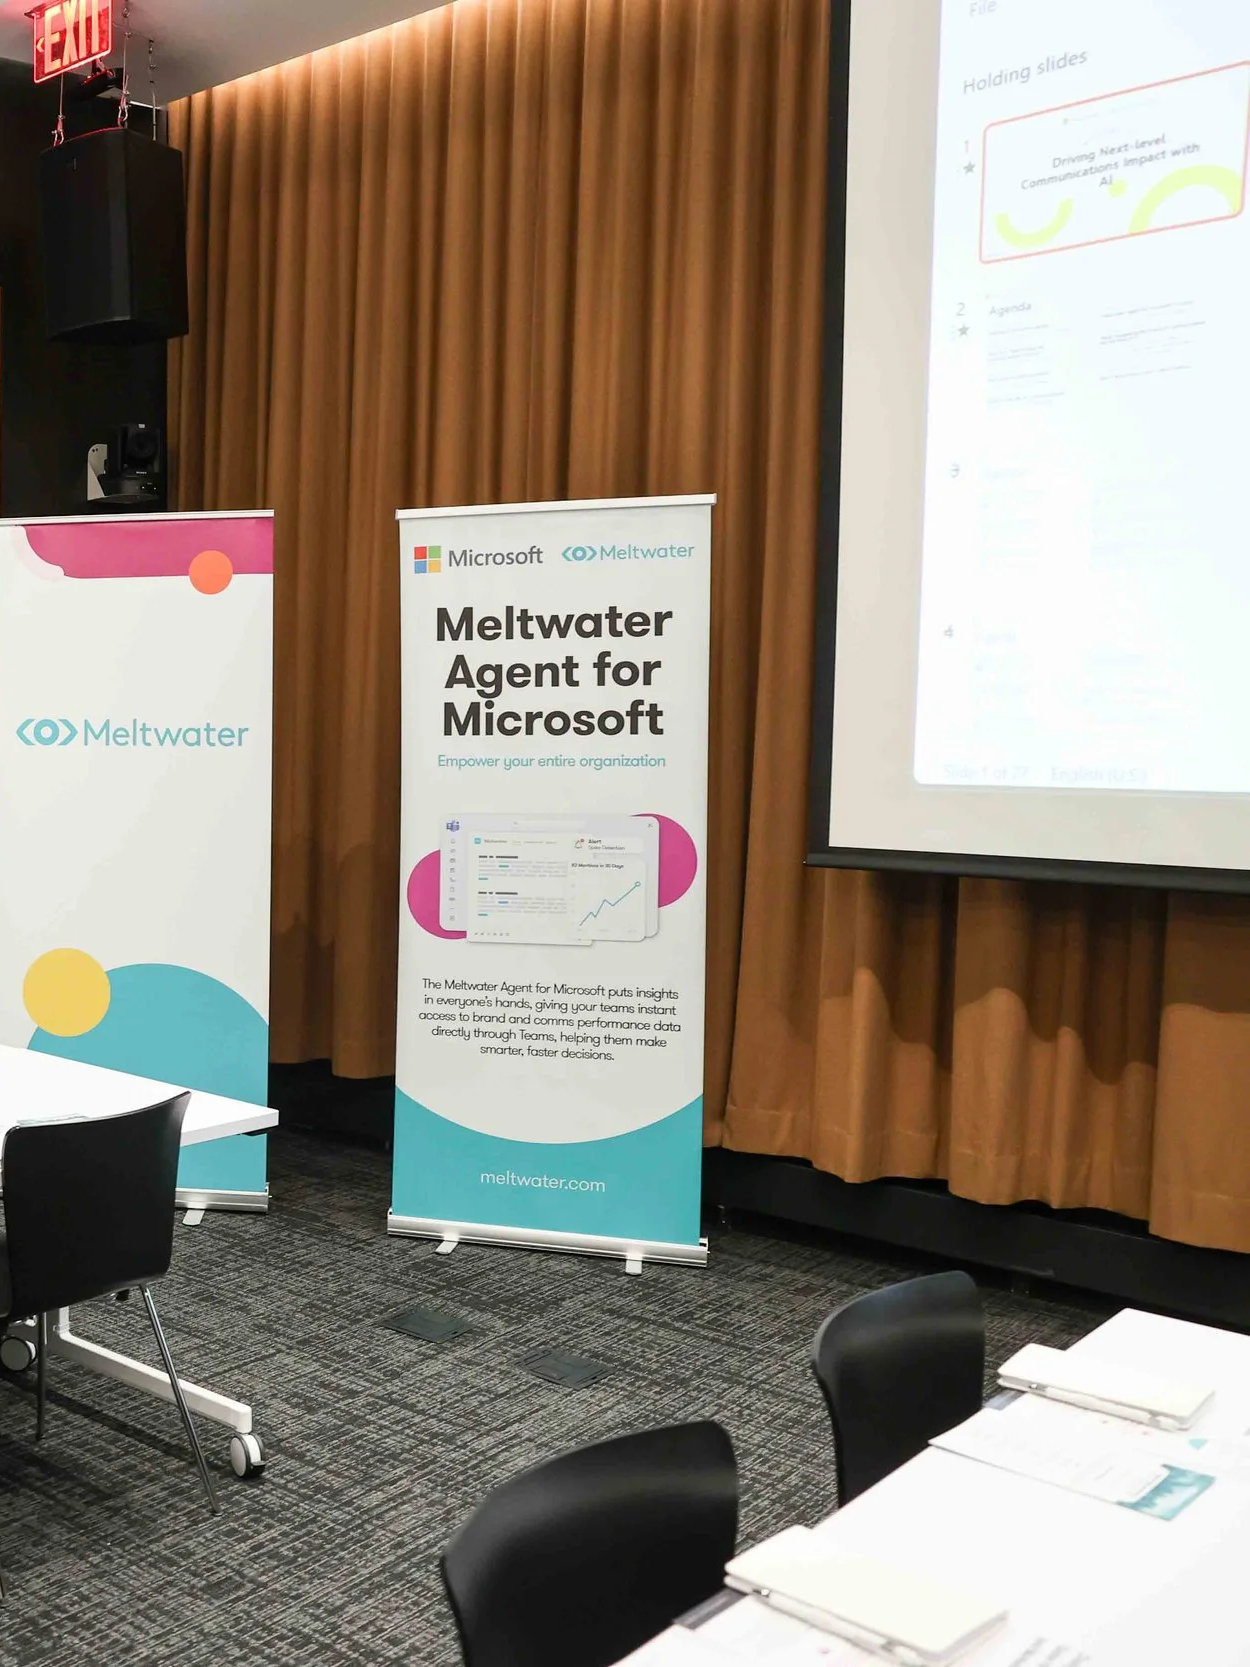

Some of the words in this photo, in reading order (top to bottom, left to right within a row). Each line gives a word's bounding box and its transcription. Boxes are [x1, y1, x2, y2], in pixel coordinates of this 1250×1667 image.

[44, 0, 99, 74] EXIT
[963, 64, 1031, 95] Holding
[1037, 48, 1088, 76] slides
[1052, 150, 1096, 169] Driving
[1100, 133, 1166, 157] Next-level
[1020, 160, 1119, 191] Communications
[1123, 149, 1166, 170] Impact
[1171, 142, 1200, 158] with
[955, 302, 967, 316] 2
[988, 301, 1032, 318] Agenda
[448, 545, 544, 567] Microsoft
[600, 543, 695, 561] Meltwater
[436, 605, 673, 641] Meltwater
[444, 654, 579, 699] Agent
[593, 651, 662, 687] for
[443, 699, 664, 736] Microsoft
[83, 718, 249, 747] Meltwater
[438, 754, 500, 770] Empower
[503, 756, 535, 771] your
[538, 754, 577, 768] entire
[579, 754, 666, 771] organization
[422, 978, 441, 990] The
[444, 979, 498, 992] Meltwater
[500, 981, 533, 996] Agent
[535, 982, 551, 994] for
[554, 983, 605, 996] Microsoft
[608, 986, 633, 1000] puts
[636, 986, 679, 1002] insights
[424, 994, 434, 1005] in
[436, 995, 493, 1009] everyone's
[495, 997, 533, 1011] hands,
[535, 999, 568, 1014] giving
[571, 1002, 598, 1014] your
[600, 1002, 635, 1014] teams
[637, 1003, 677, 1016] instant
[418, 1011, 456, 1022] access
[459, 1012, 470, 1022] to
[473, 1011, 506, 1024] brand
[508, 1013, 531, 1025] and
[533, 1016, 574, 1027] comms
[577, 1017, 650, 1032] performance
[653, 1020, 681, 1032] data
[431, 1026, 471, 1041] directly
[474, 1028, 517, 1043] through
[519, 1030, 557, 1043] Teams,
[560, 1032, 601, 1047] helping
[603, 1034, 633, 1046] them
[636, 1035, 667, 1048] make
[480, 1045, 524, 1057] smarter,
[527, 1045, 558, 1058] faster
[561, 1047, 615, 1061] decisions.
[480, 1170, 606, 1193] meltwater.com
